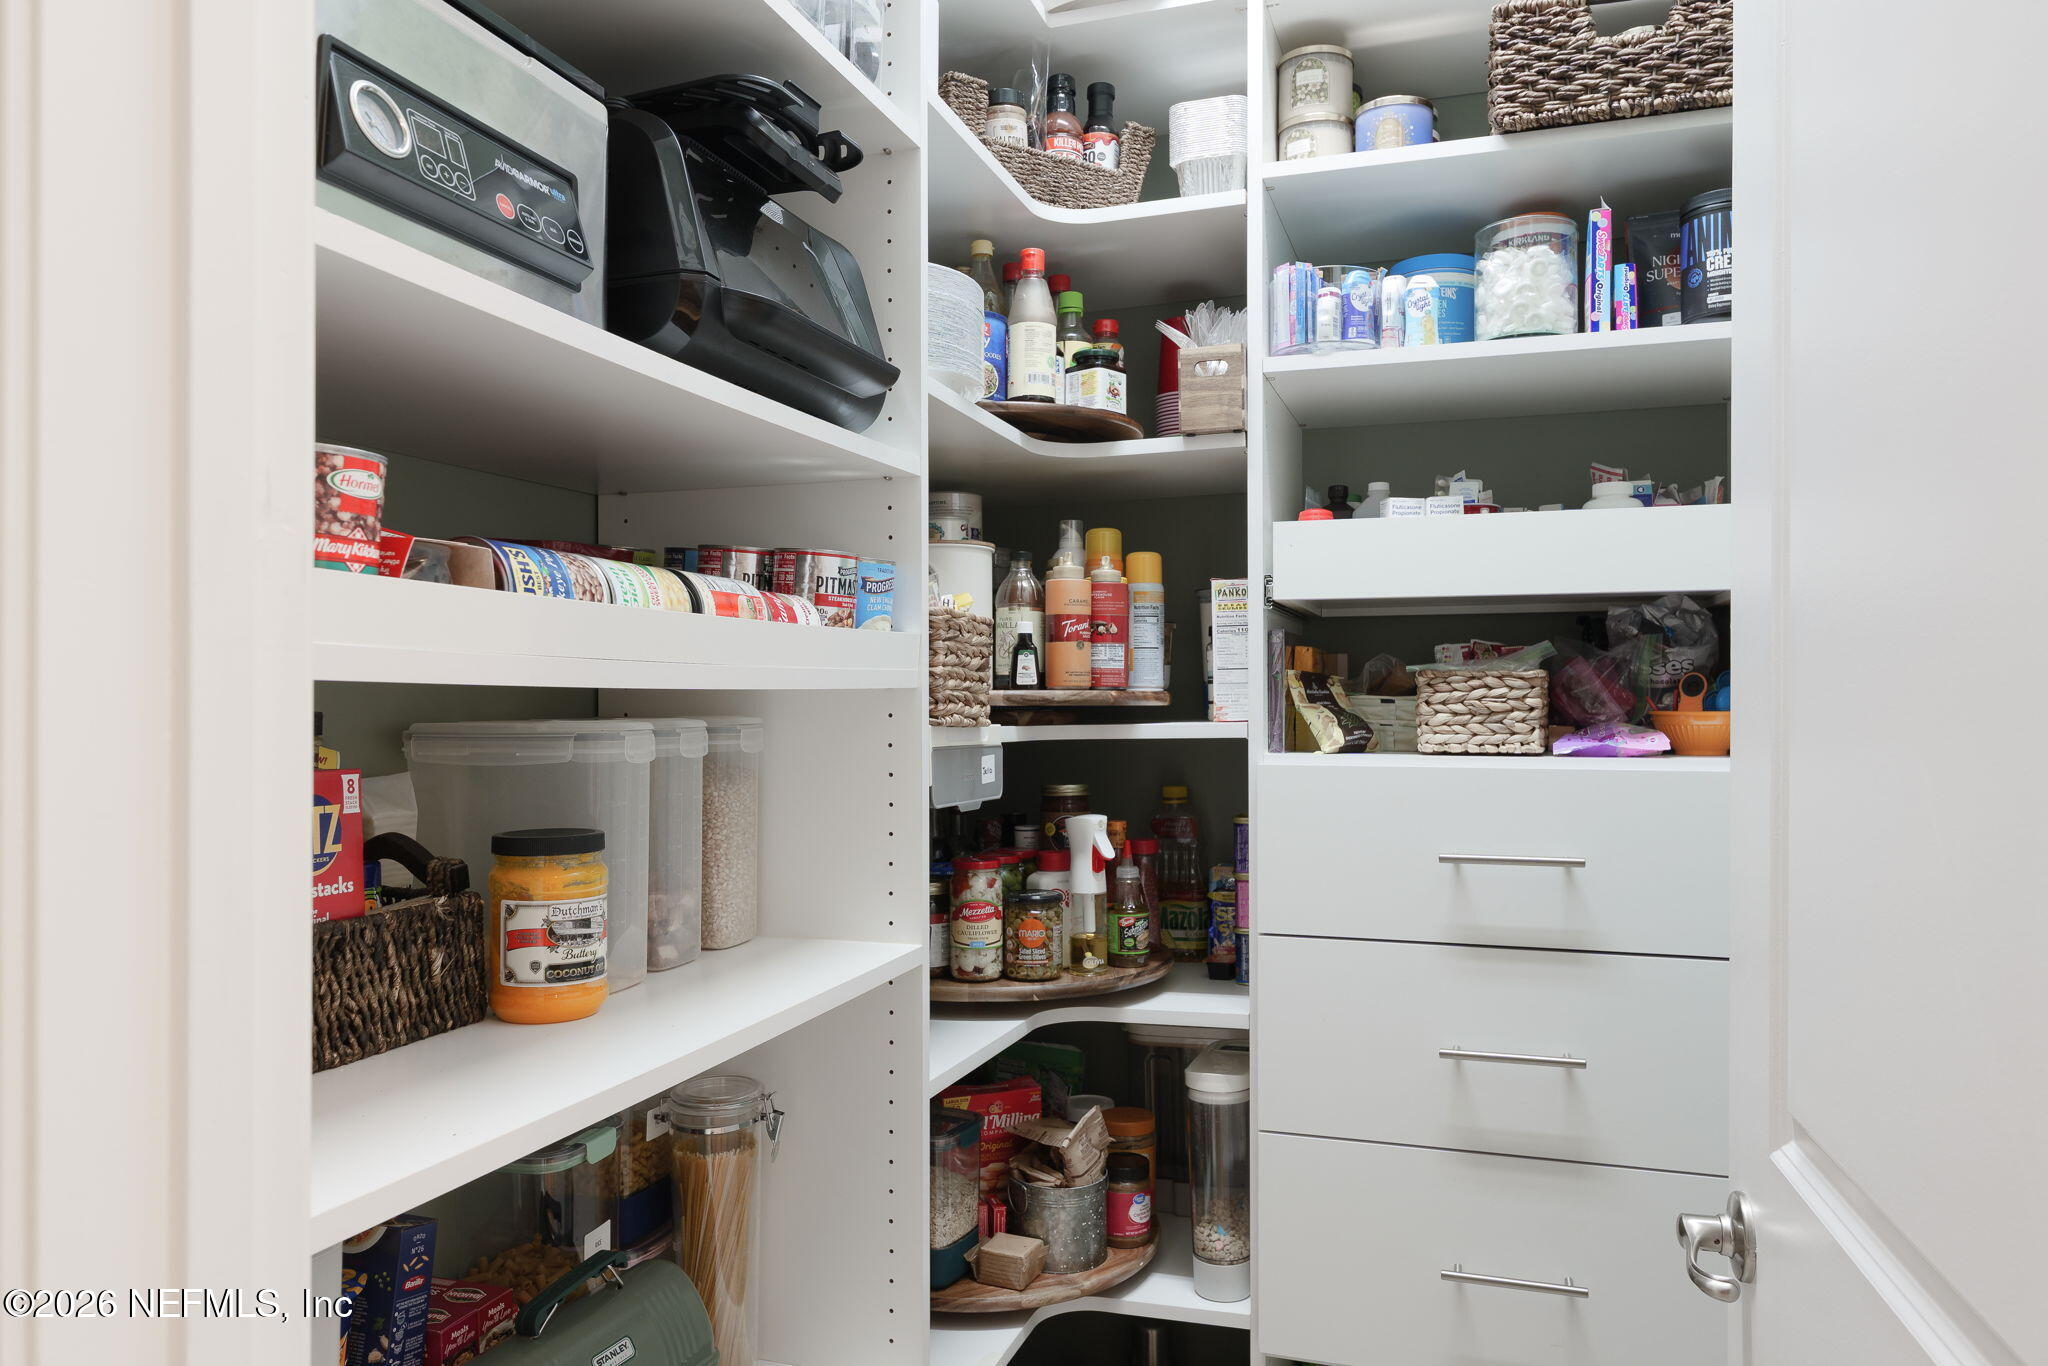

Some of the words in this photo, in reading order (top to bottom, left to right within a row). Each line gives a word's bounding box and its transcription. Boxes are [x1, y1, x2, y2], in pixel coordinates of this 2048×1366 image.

[1508, 234, 1550, 246] KIRKLAND
[1594, 282, 1604, 313] Original
[1217, 588, 1247, 598] PANKO
[1061, 619, 1090, 638] Torani
[346, 778, 355, 795] 8
[551, 903, 603, 918] Dutchman's
[960, 906, 997, 918] Mezzetta
[1018, 929, 1046, 938] MARIO
[561, 948, 598, 964] Buttery
[545, 965, 596, 979] COCONUT
[404, 1278, 424, 1290] Barilla
[488, 1302, 505, 1318] Meals
[451, 1324, 469, 1341] Meals
[596, 1341, 629, 1366] STANLEY
